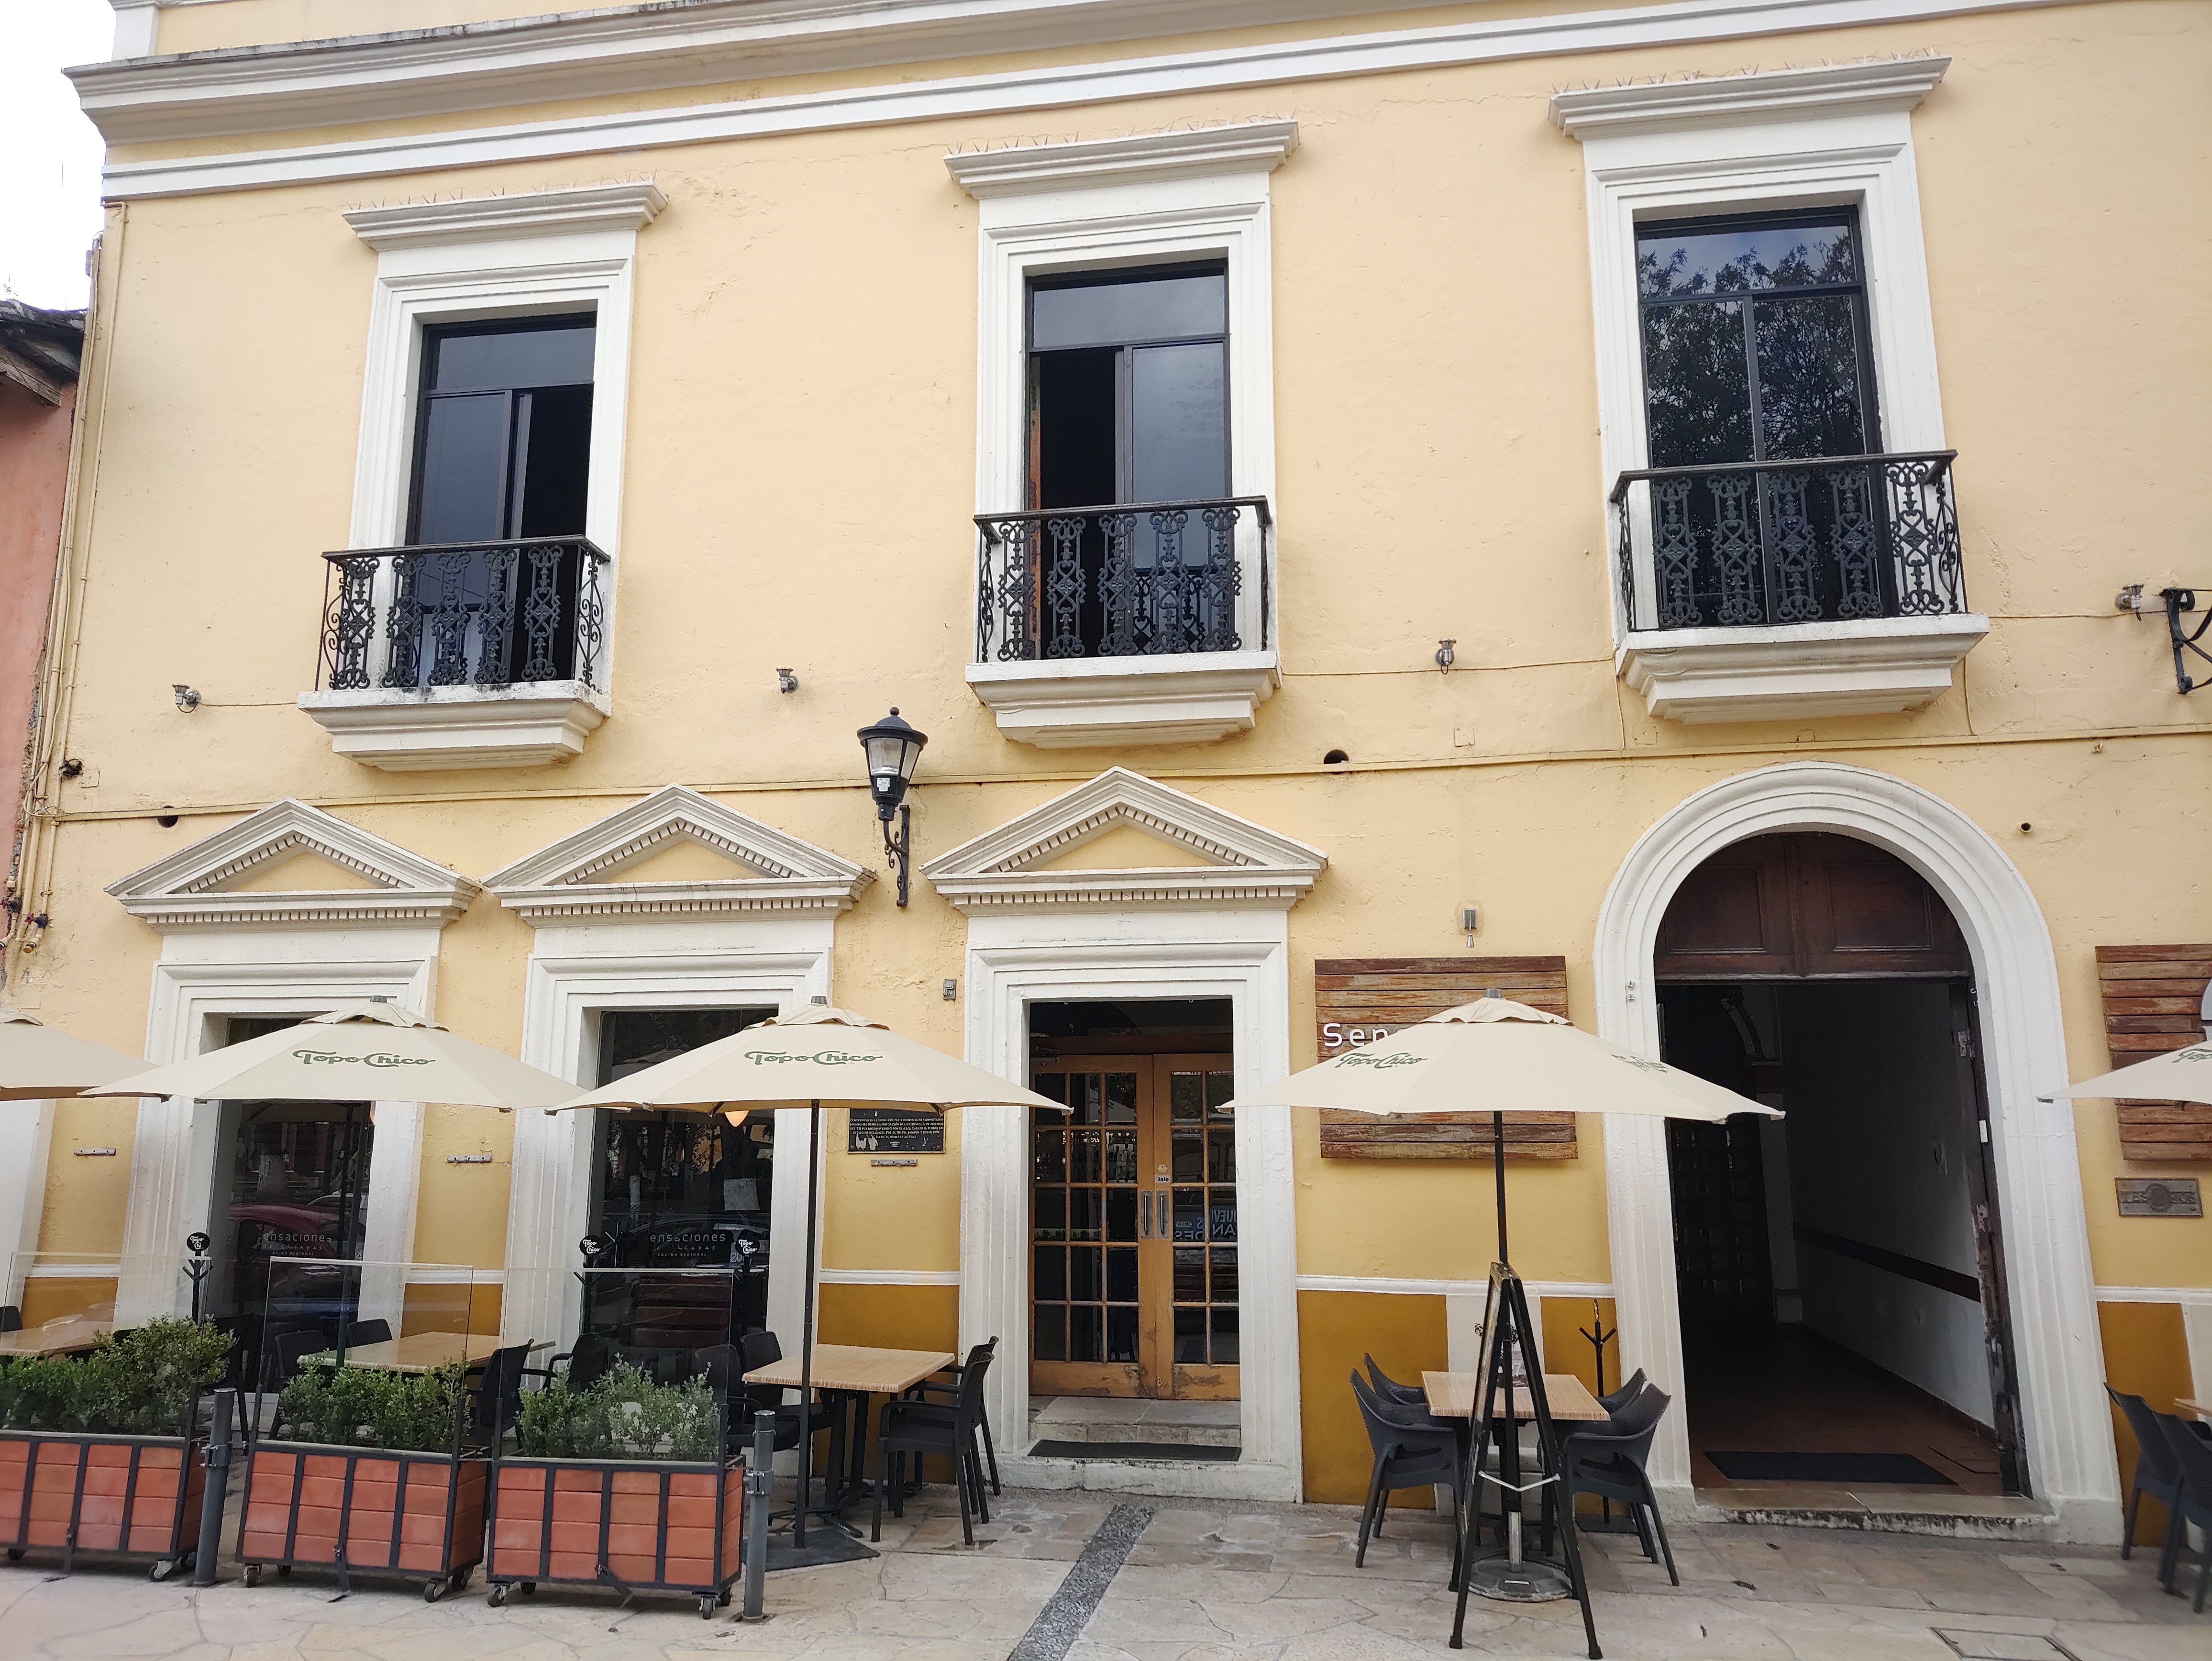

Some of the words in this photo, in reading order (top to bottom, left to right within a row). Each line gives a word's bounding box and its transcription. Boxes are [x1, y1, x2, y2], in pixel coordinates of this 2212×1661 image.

[292, 1050, 360, 1064] Topo
[363, 1052, 436, 1067] Chico
[744, 1051, 809, 1065] Topo
[813, 1051, 883, 1065] Chico
[1335, 1052, 1380, 1068] Topo
[1374, 1052, 1428, 1069] Chico
[582, 1239, 597, 1247] Topo
[738, 1239, 753, 1248] Topo
[586, 1246, 601, 1254] Chico
[742, 1246, 757, 1254] Chico
